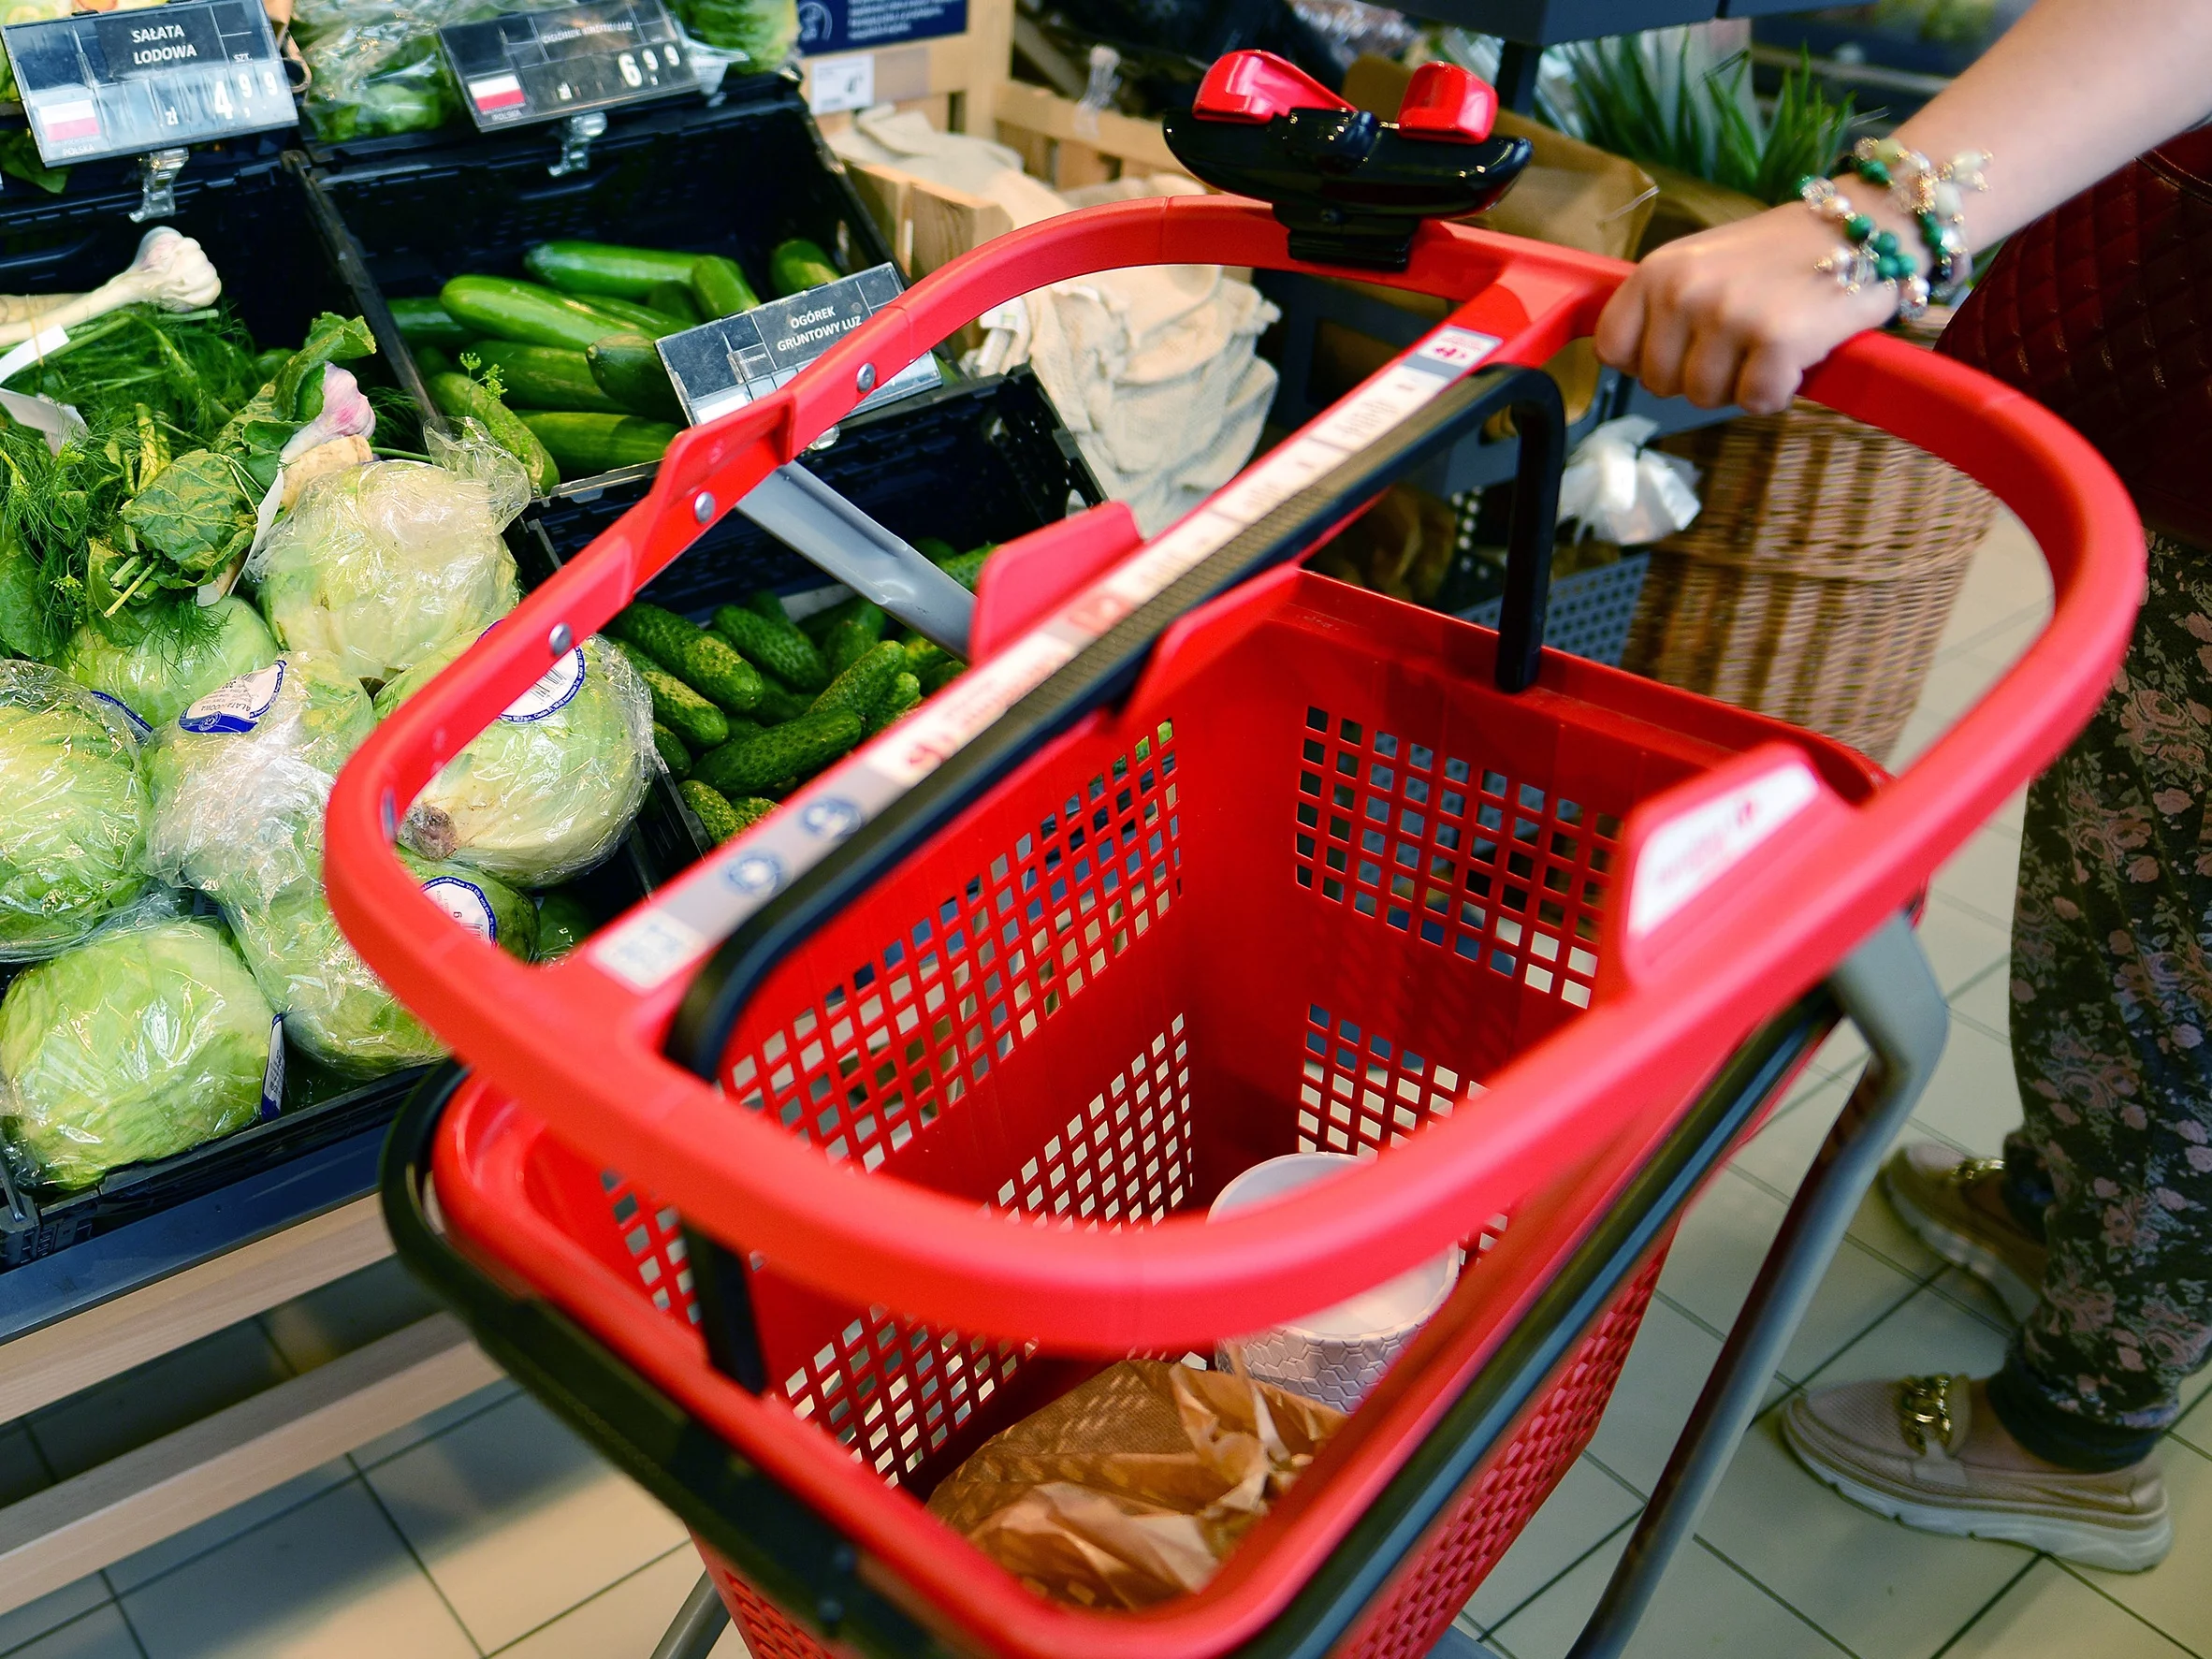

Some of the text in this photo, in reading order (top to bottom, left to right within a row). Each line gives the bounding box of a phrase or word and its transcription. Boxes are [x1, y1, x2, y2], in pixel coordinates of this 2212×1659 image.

[131, 23, 185, 44] SAŁATA
[133, 44, 198, 65] LODOWA
[165, 107, 180, 126] zł
[63, 144, 95, 156] POLSKA
[790, 306, 837, 329] OGÓREK
[777, 315, 863, 353] GRUNTOWY LUZ
